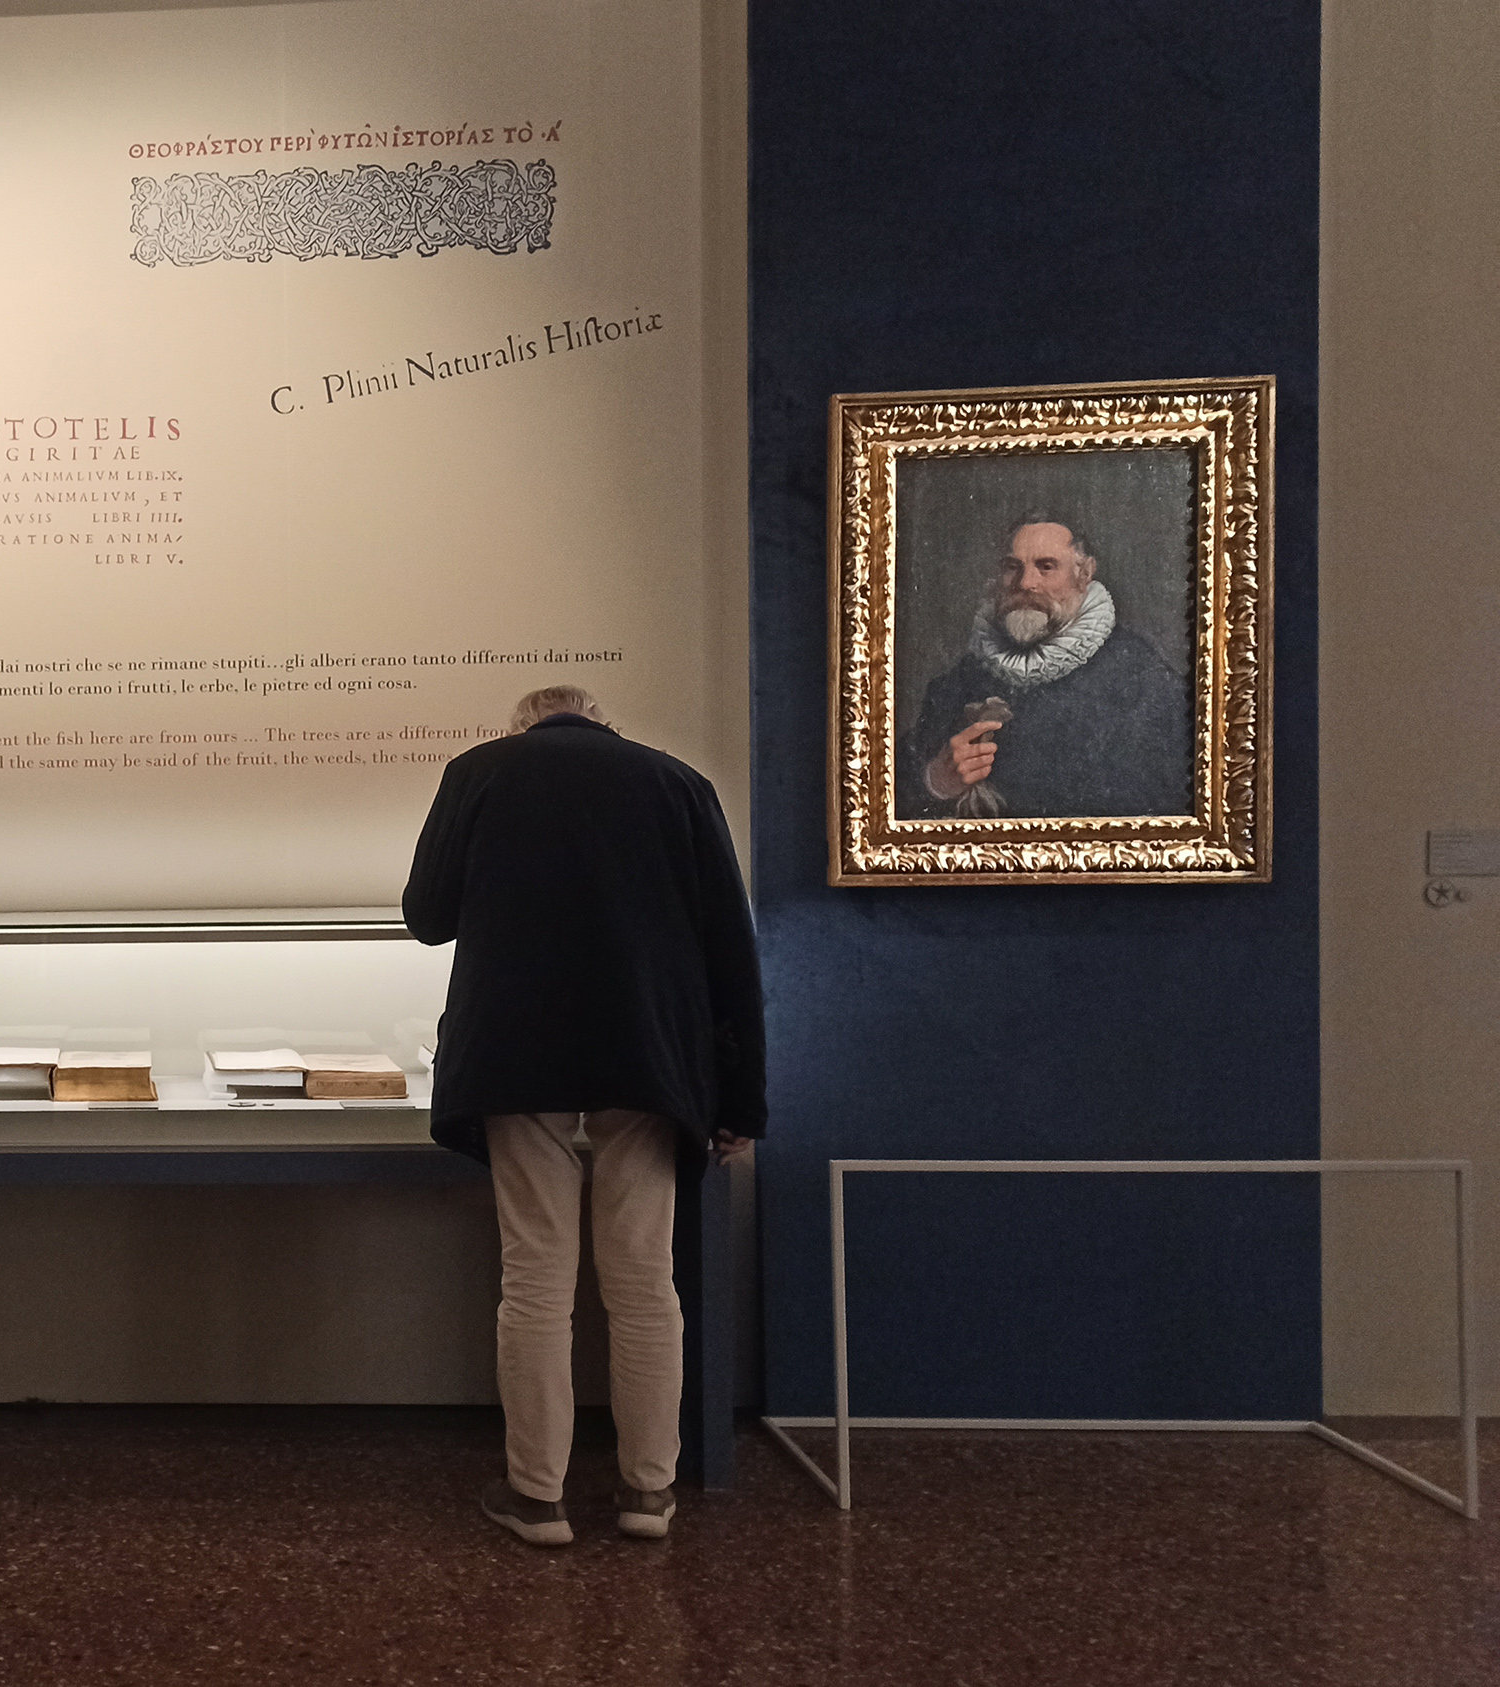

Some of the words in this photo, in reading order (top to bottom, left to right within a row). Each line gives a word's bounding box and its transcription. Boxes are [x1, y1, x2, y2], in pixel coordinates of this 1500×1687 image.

[271, 386, 303, 414] C.
[323, 365, 398, 407] Plinii
[406, 334, 537, 385] Naturalis
[22, 471, 118, 481] ANIMALIVM
[161, 492, 182, 501] ET
[93, 512, 140, 522] LIBRI
[96, 554, 150, 564] LIBRI
[167, 554, 183, 564] V.
[26, 659, 70, 672] nostri
[76, 658, 102, 671] che
[129, 662, 145, 670] ne
[152, 657, 206, 670] rimane
[311, 653, 355, 667] alberi
[362, 656, 406, 666] erano
[413, 654, 456, 665] tanto
[462, 650, 537, 664] differenti
[544, 649, 568, 662] dai
[575, 648, 622, 662] nostri
[50, 682, 62, 695] lo
[68, 685, 111, 694] erano
[118, 681, 121, 693] i
[129, 681, 176, 693] frutti,
[182, 679, 194, 692] le
[200, 679, 238, 693] erbe,
[245, 678, 256, 691] le
[263, 679, 308, 696] pietre
[314, 677, 331, 690] ed
[338, 677, 371, 694] ogni
[378, 679, 416, 689] cosa.
[27, 732, 50, 745] the
[57, 731, 83, 745] fish
[90, 731, 123, 744] here
[130, 735, 153, 744] are
[160, 731, 197, 743] from
[204, 733, 237, 742] ours
[265, 728, 295, 741] The
[303, 730, 339, 741] trees
[346, 731, 370, 740] are
[377, 731, 393, 739] as
[399, 726, 467, 739] different
[10, 755, 33, 768] the
[39, 760, 78, 768] same
[85, 758, 115, 771] may
[124, 754, 140, 767] be
[146, 753, 176, 766] said
[183, 753, 199, 766] of
[207, 752, 230, 766] the
[237, 752, 277, 765] fruit,
[284, 751, 308, 764] the
[314, 750, 366, 765] weeds,
[373, 750, 397, 763] the
